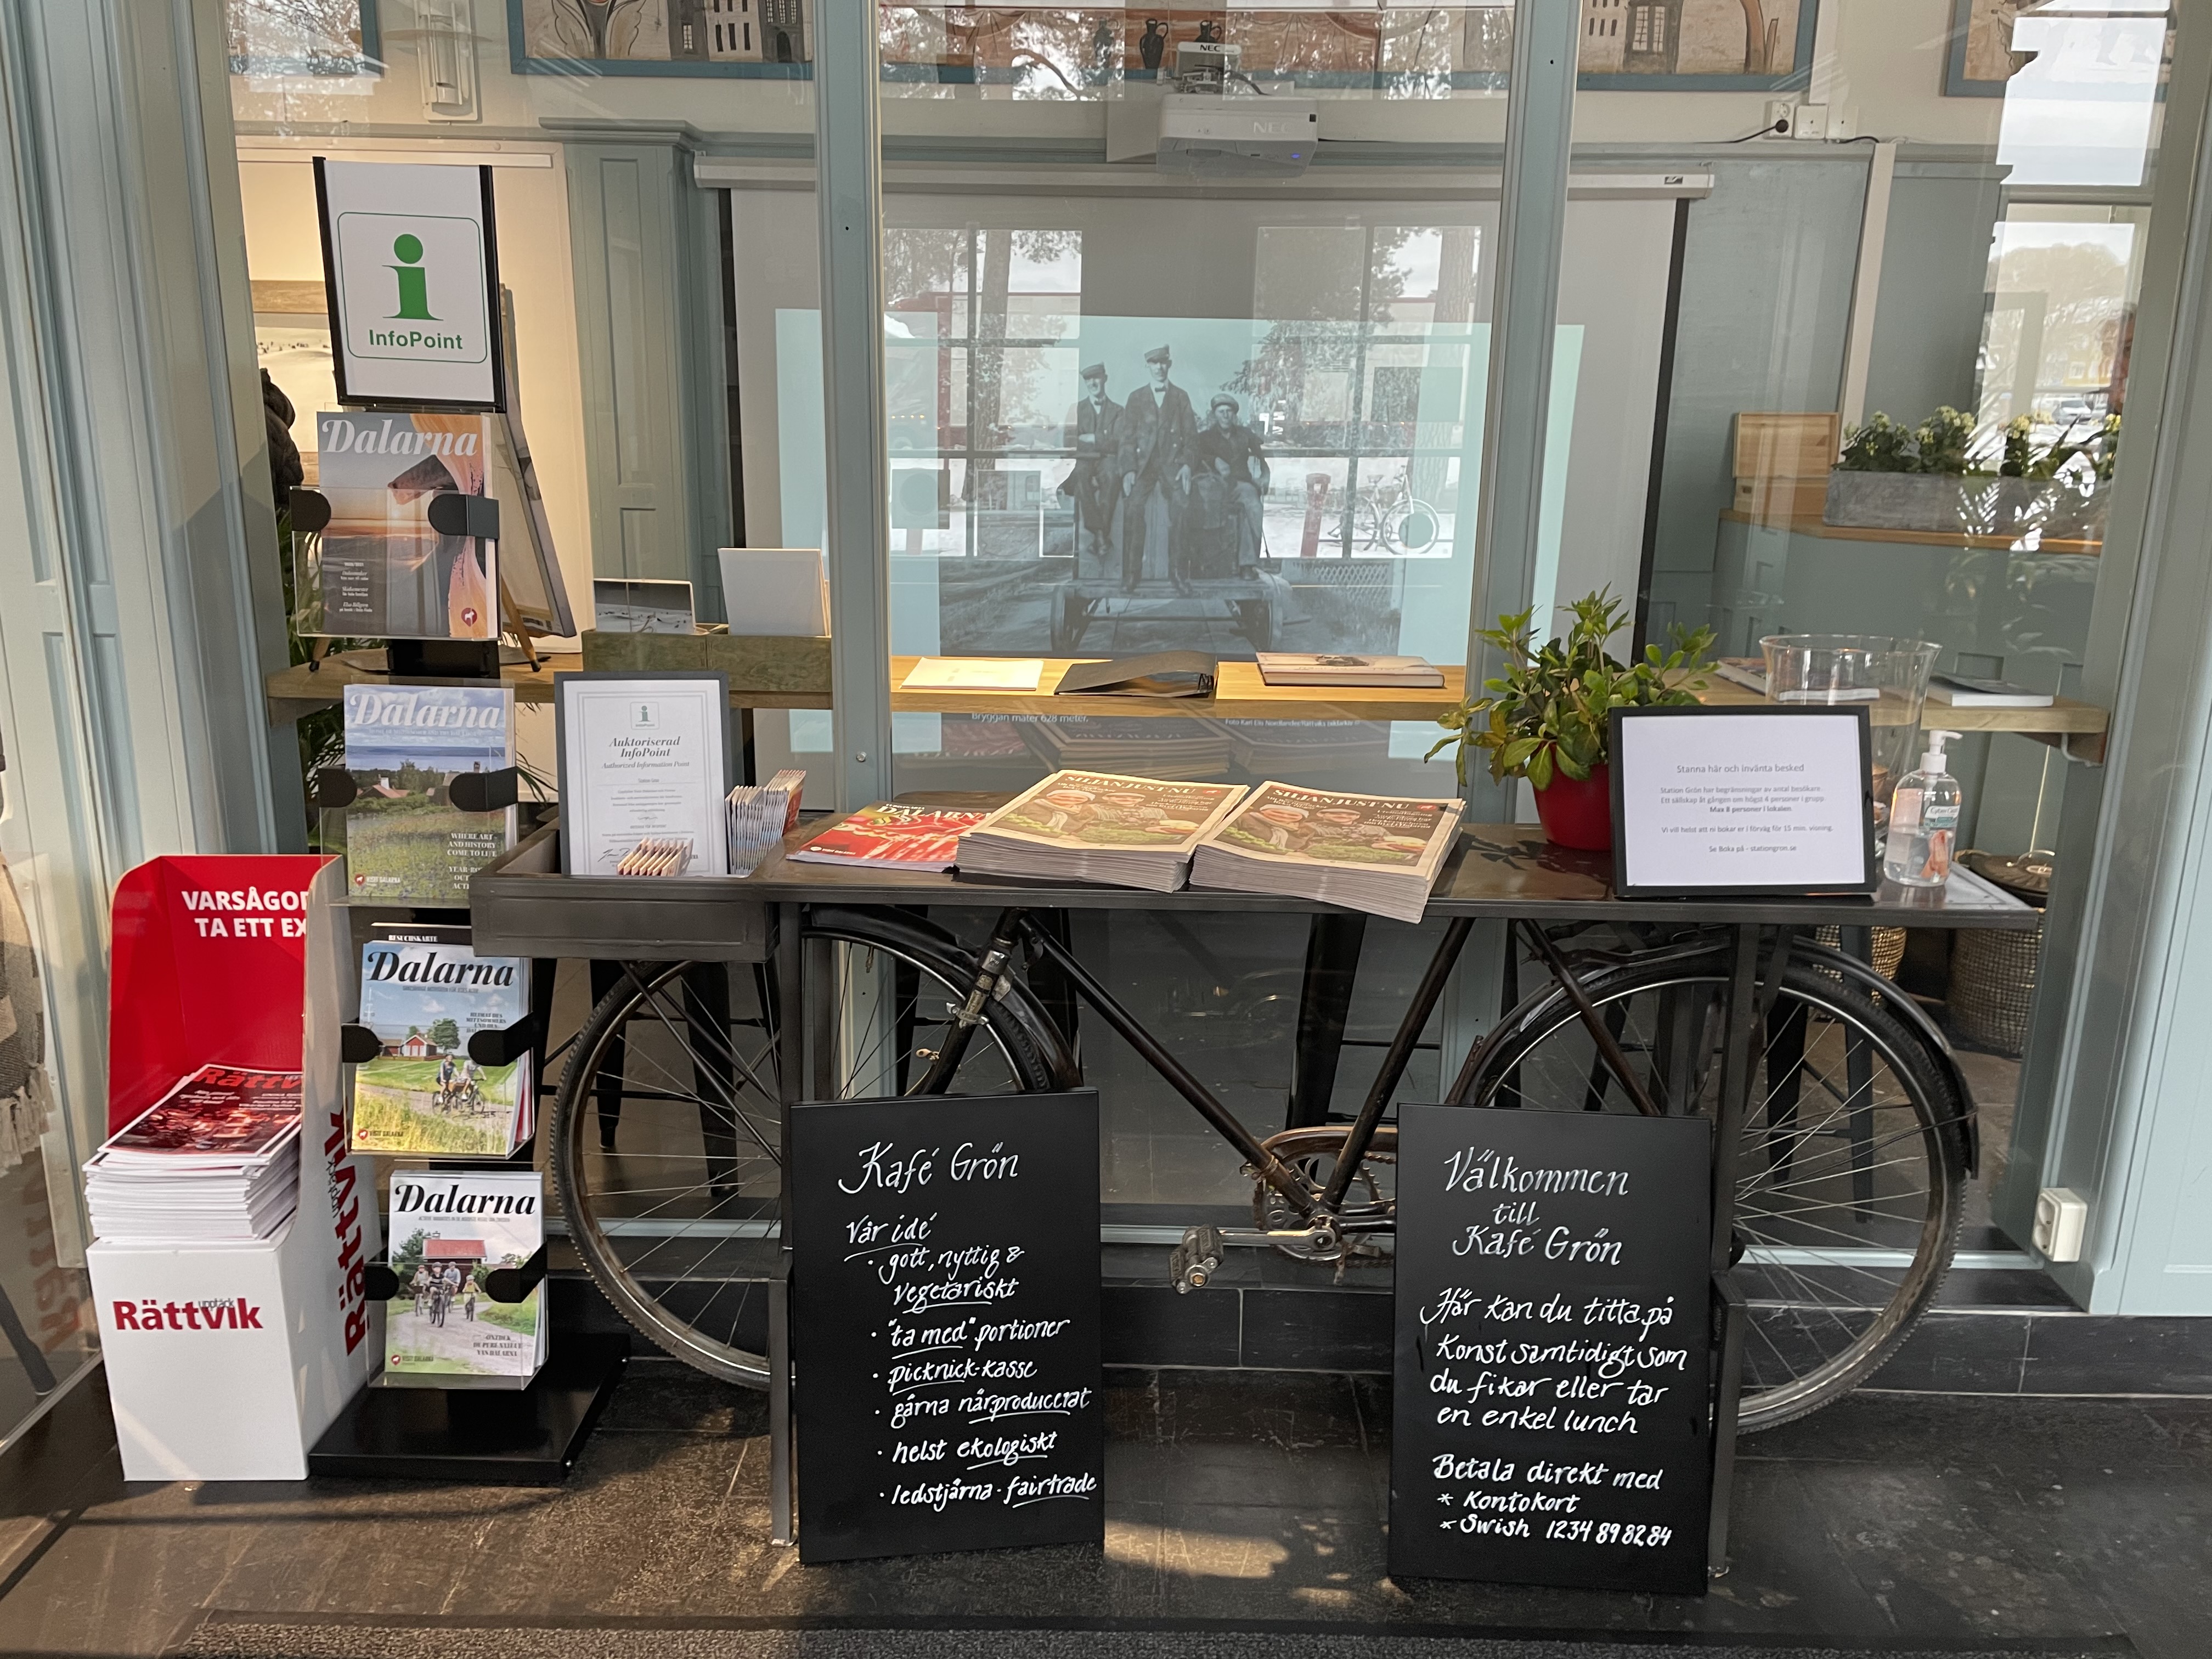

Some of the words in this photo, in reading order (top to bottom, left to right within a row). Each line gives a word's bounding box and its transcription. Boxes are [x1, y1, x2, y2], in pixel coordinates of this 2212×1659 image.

[1254, 122, 1289, 133] NEC
[369, 330, 463, 349] InfoPoint
[322, 419, 478, 456] Dalarna
[350, 693, 500, 729] Dalarna
[972, 713, 1009, 723] Bryggan
[609, 736, 680, 747] Auktoriserad
[620, 748, 670, 760] InfoPoint
[1677, 765, 1706, 773] Stanna
[1708, 764, 1722, 772] här
[1724, 764, 1739, 772] och
[1741, 764, 1773, 772] invänta
[1775, 763, 1804, 771] besked
[1120, 782, 1168, 792] JUST
[1273, 789, 1332, 804] SILJAN
[1332, 798, 1380, 807] JUST
[194, 917, 229, 938] TA
[233, 917, 274, 938] ETT
[366, 951, 514, 986] Dalarna
[838, 1141, 939, 1194] Kafé
[951, 1142, 1018, 1181] Grön
[1444, 1146, 1629, 1195] Välkommen
[394, 1184, 535, 1215] Dalarna
[1492, 1201, 1539, 1226] till
[324, 1105, 370, 1356] Rättvik
[891, 1212, 938, 1243] idé
[1452, 1225, 1541, 1259] Kafé
[1544, 1226, 1622, 1265] Grön
[878, 1246, 934, 1284] gott,
[938, 1245, 1000, 1280] nyttig
[112, 1298, 264, 1330] Rättvik
[1419, 1287, 1482, 1324] Här
[1539, 1293, 1572, 1323] du
[1584, 1297, 1641, 1325] titta
[1638, 1296, 1674, 1342] på
[974, 1319, 1070, 1351] portioner
[888, 1358, 1037, 1392] picknick-kasse
[1510, 1340, 1635, 1379] samtidigt
[1637, 1346, 1687, 1370] som
[1430, 1368, 1463, 1394] du
[1468, 1372, 1552, 1403] fikar
[1556, 1376, 1624, 1399] eller
[1627, 1380, 1669, 1406] tar
[890, 1393, 950, 1429] gärna
[958, 1387, 1092, 1422] närproducerat
[1437, 1407, 1471, 1426] en
[1482, 1406, 1557, 1429] enkel
[1564, 1410, 1638, 1434] lunch
[892, 1440, 947, 1464] helst
[957, 1431, 1058, 1466] ekologiskt
[1432, 1453, 1515, 1481] Betala
[1527, 1460, 1609, 1485] direkt
[1612, 1469, 1663, 1491] med
[1003, 1472, 1097, 1505] fairtrade
[1463, 1491, 1581, 1514] Kontokort
[1460, 1514, 1530, 1537] Swish
[1545, 1520, 1593, 1542] 1234
